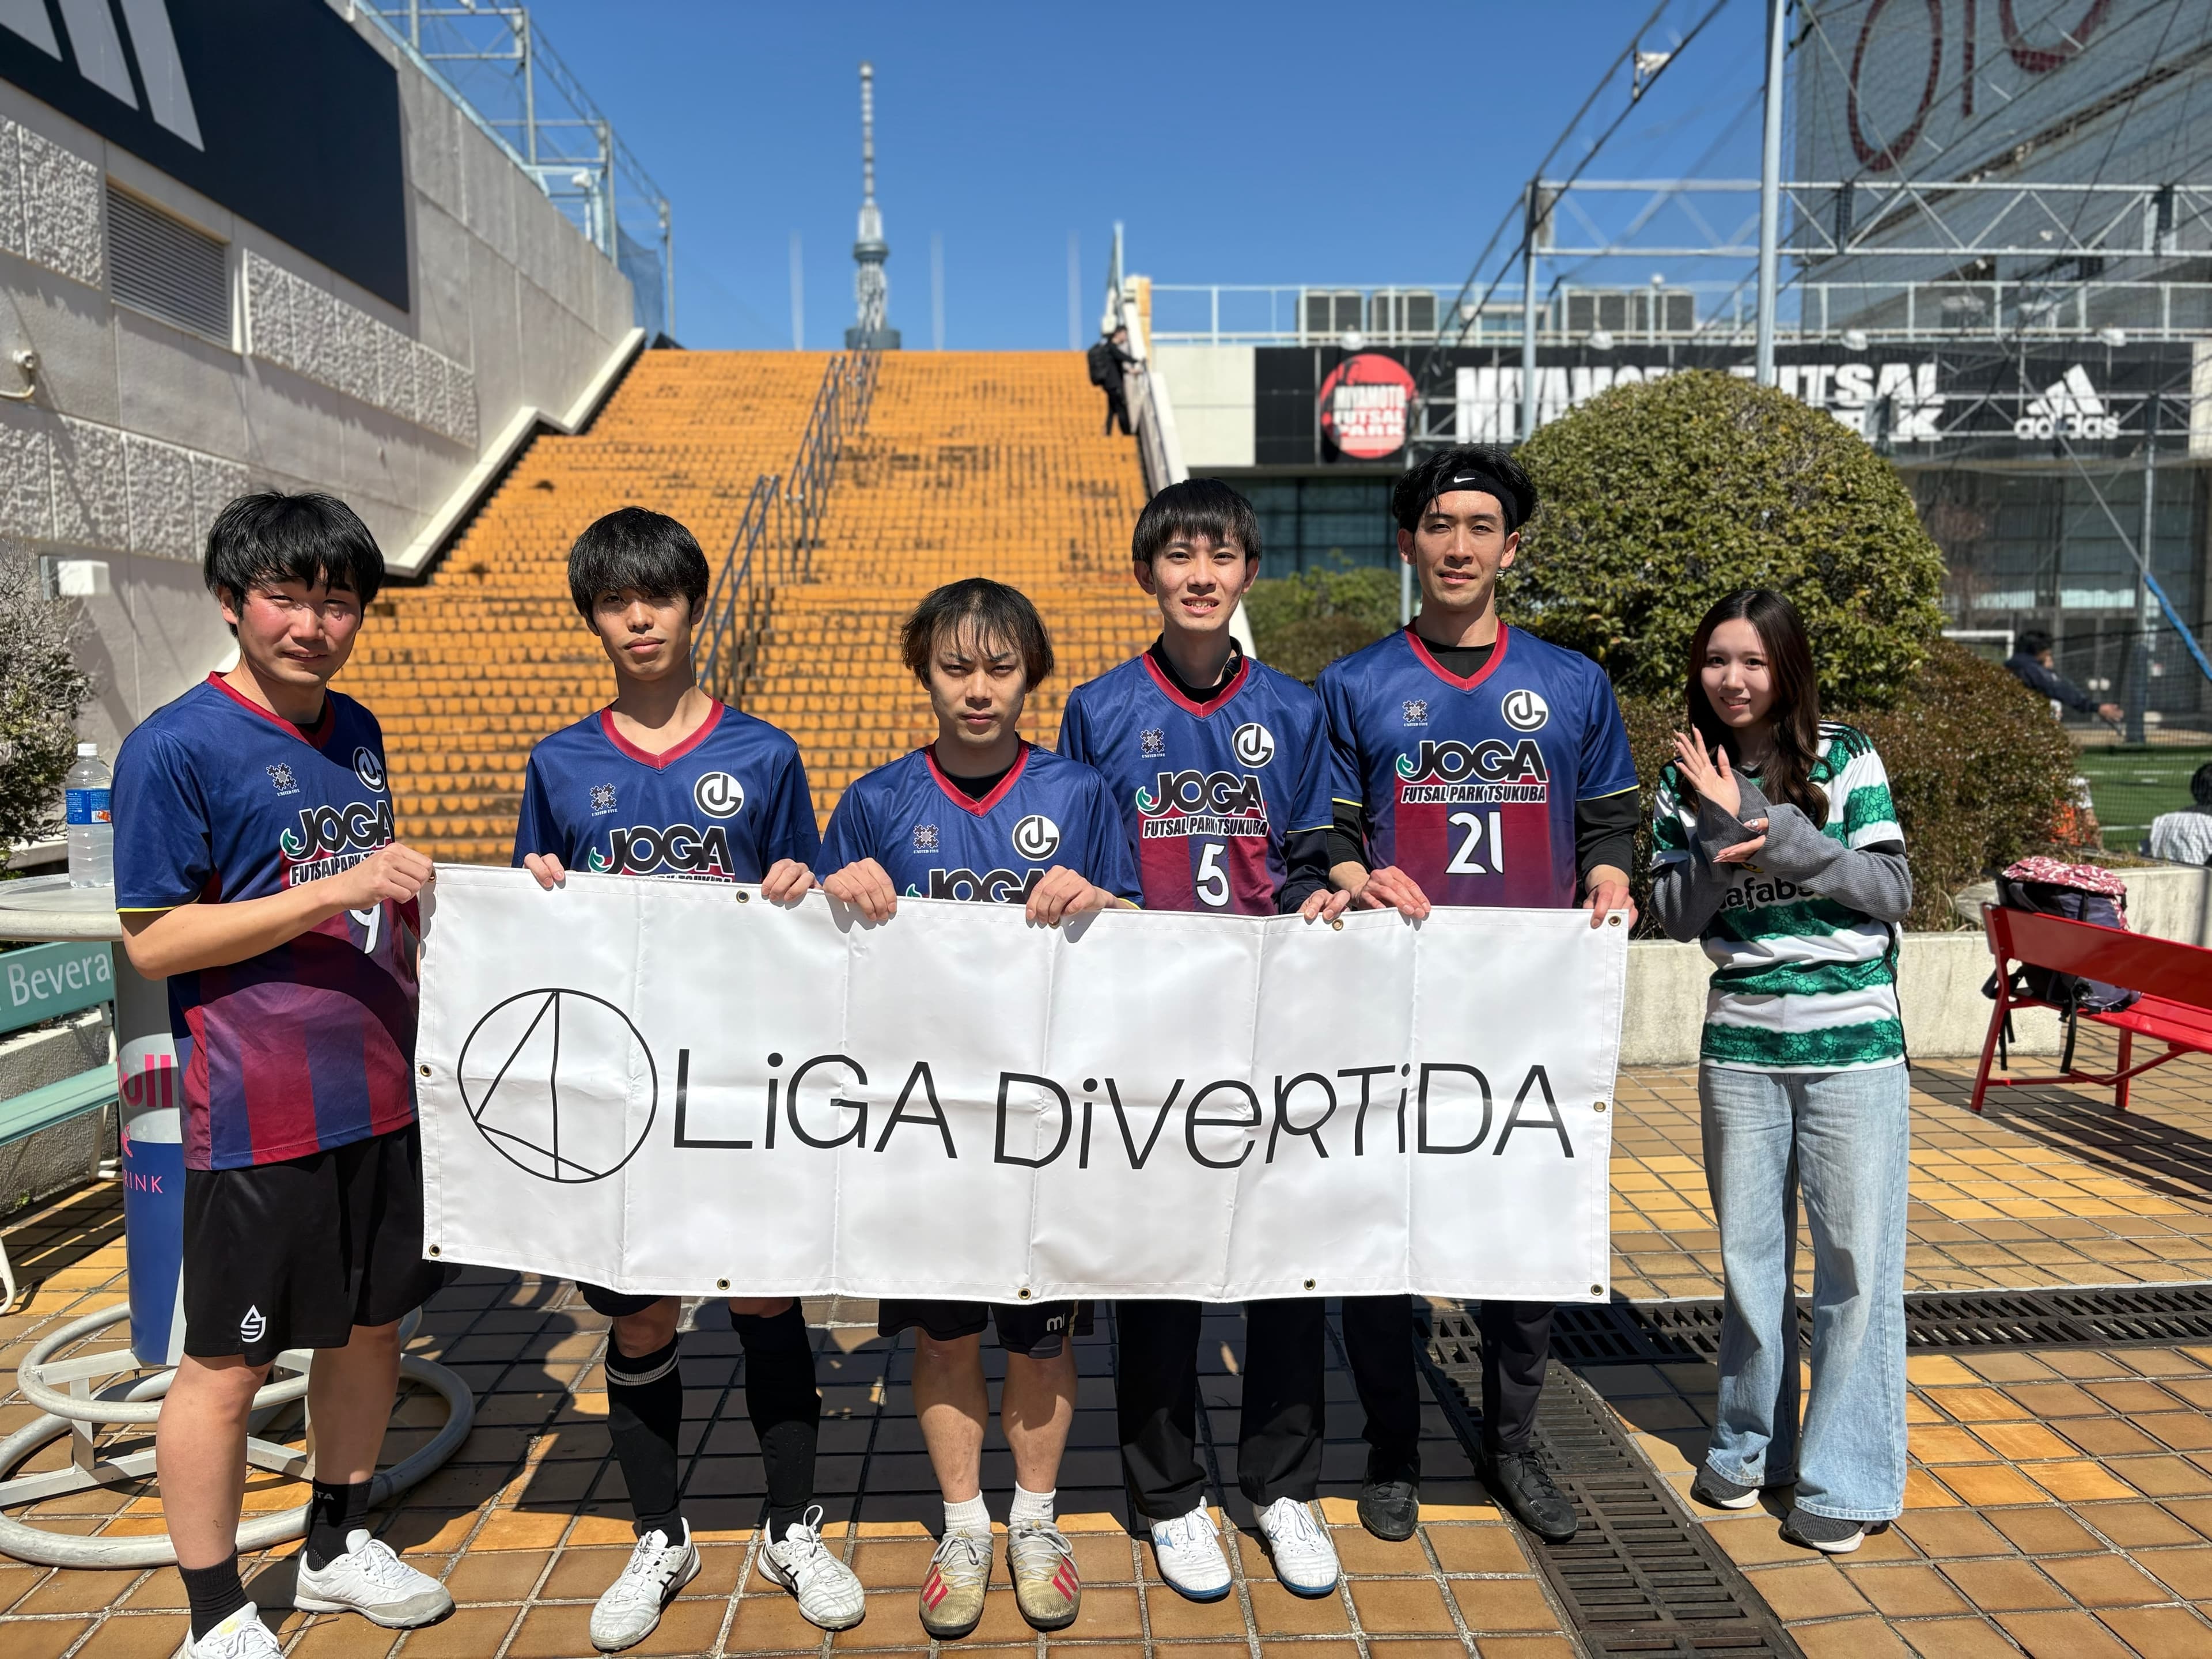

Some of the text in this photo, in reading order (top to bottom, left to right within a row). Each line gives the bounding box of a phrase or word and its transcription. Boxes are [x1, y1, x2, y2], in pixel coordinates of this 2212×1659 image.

[2014, 411, 2119, 440] addas
[1396, 739, 1549, 784] JOGA
[1135, 770, 1266, 817] JOGA
[1402, 785, 1546, 802] FUTSAL PARK TSUKUBA
[279, 800, 395, 862] JOGA
[588, 824, 735, 874] JOGA
[1144, 816, 1268, 836] FUTSAL PARK TSUKUBA
[1444, 810, 1505, 874] 21
[1195, 842, 1230, 908] 5
[7, 953, 111, 1007] Bevera
[117, 1054, 173, 1108] ull
